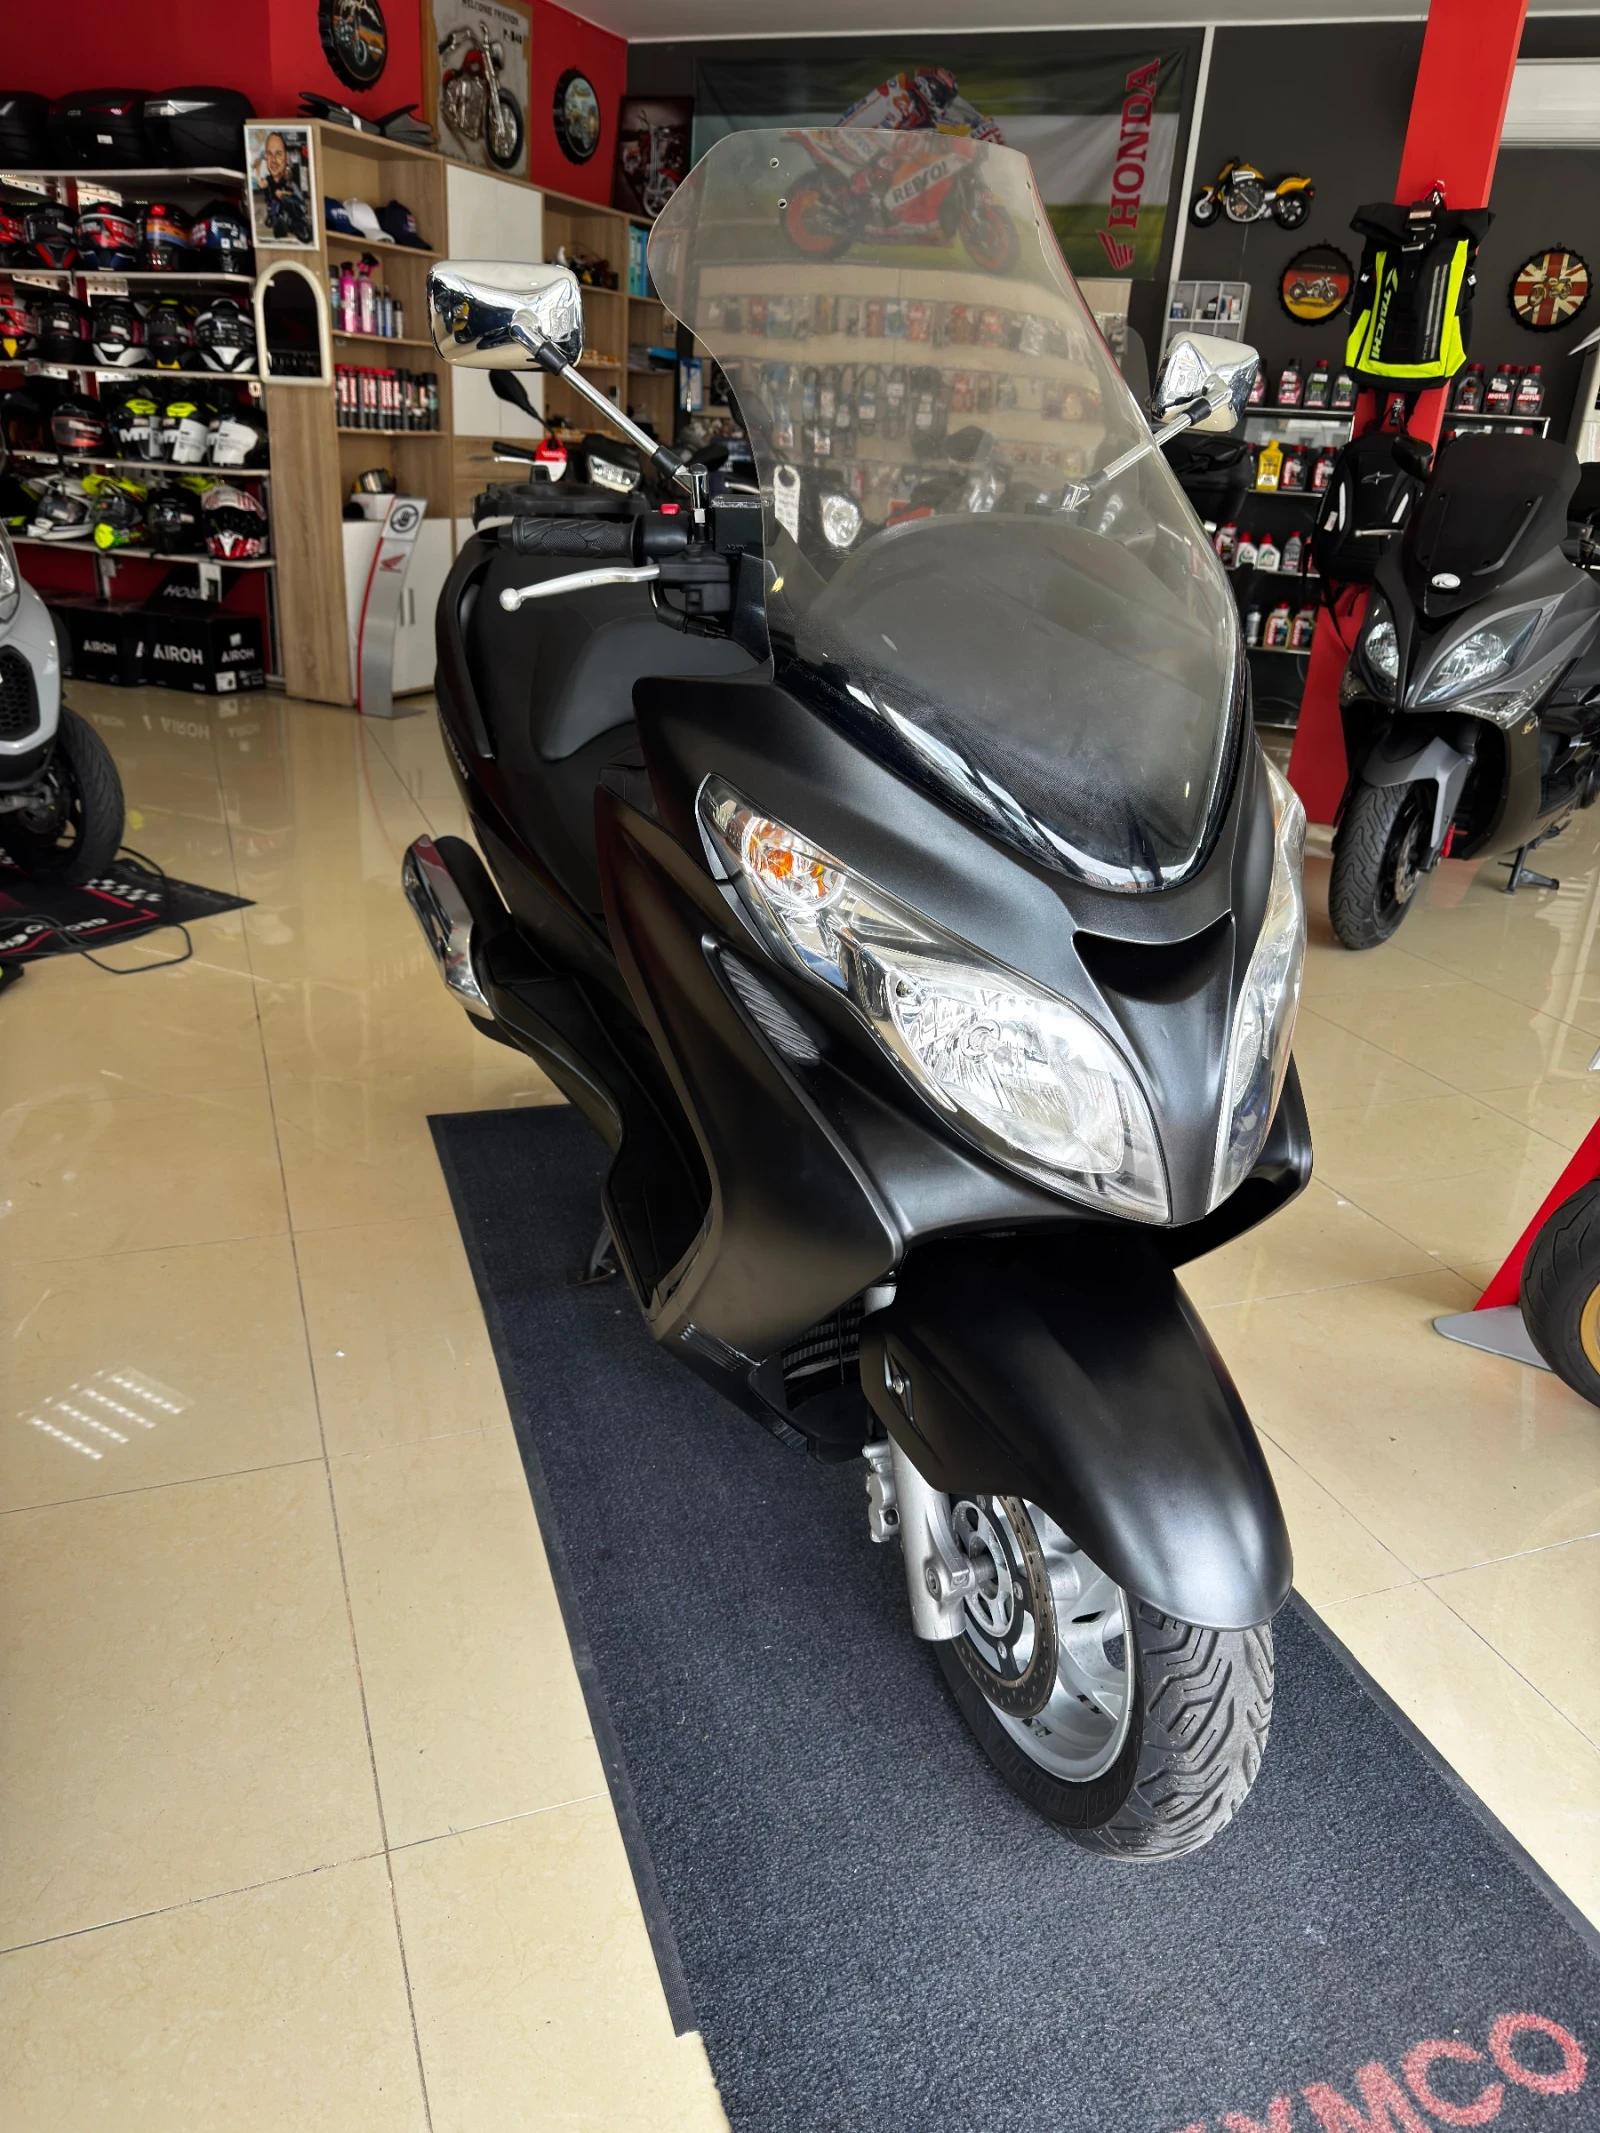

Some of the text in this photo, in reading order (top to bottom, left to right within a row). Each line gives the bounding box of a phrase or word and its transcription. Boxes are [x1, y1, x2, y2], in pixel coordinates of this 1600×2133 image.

[1107, 58, 1161, 230] HONDA
[1370, 289, 1392, 360] TAICHI
[1487, 392, 1510, 400] MOTUL
[83, 639, 117, 655] AIROH
[153, 643, 204, 665] AIROH
[221, 648, 255, 663] AIROH
[24, 917, 108, 934] OORD
[1173, 2012, 1588, 2133] MCO
